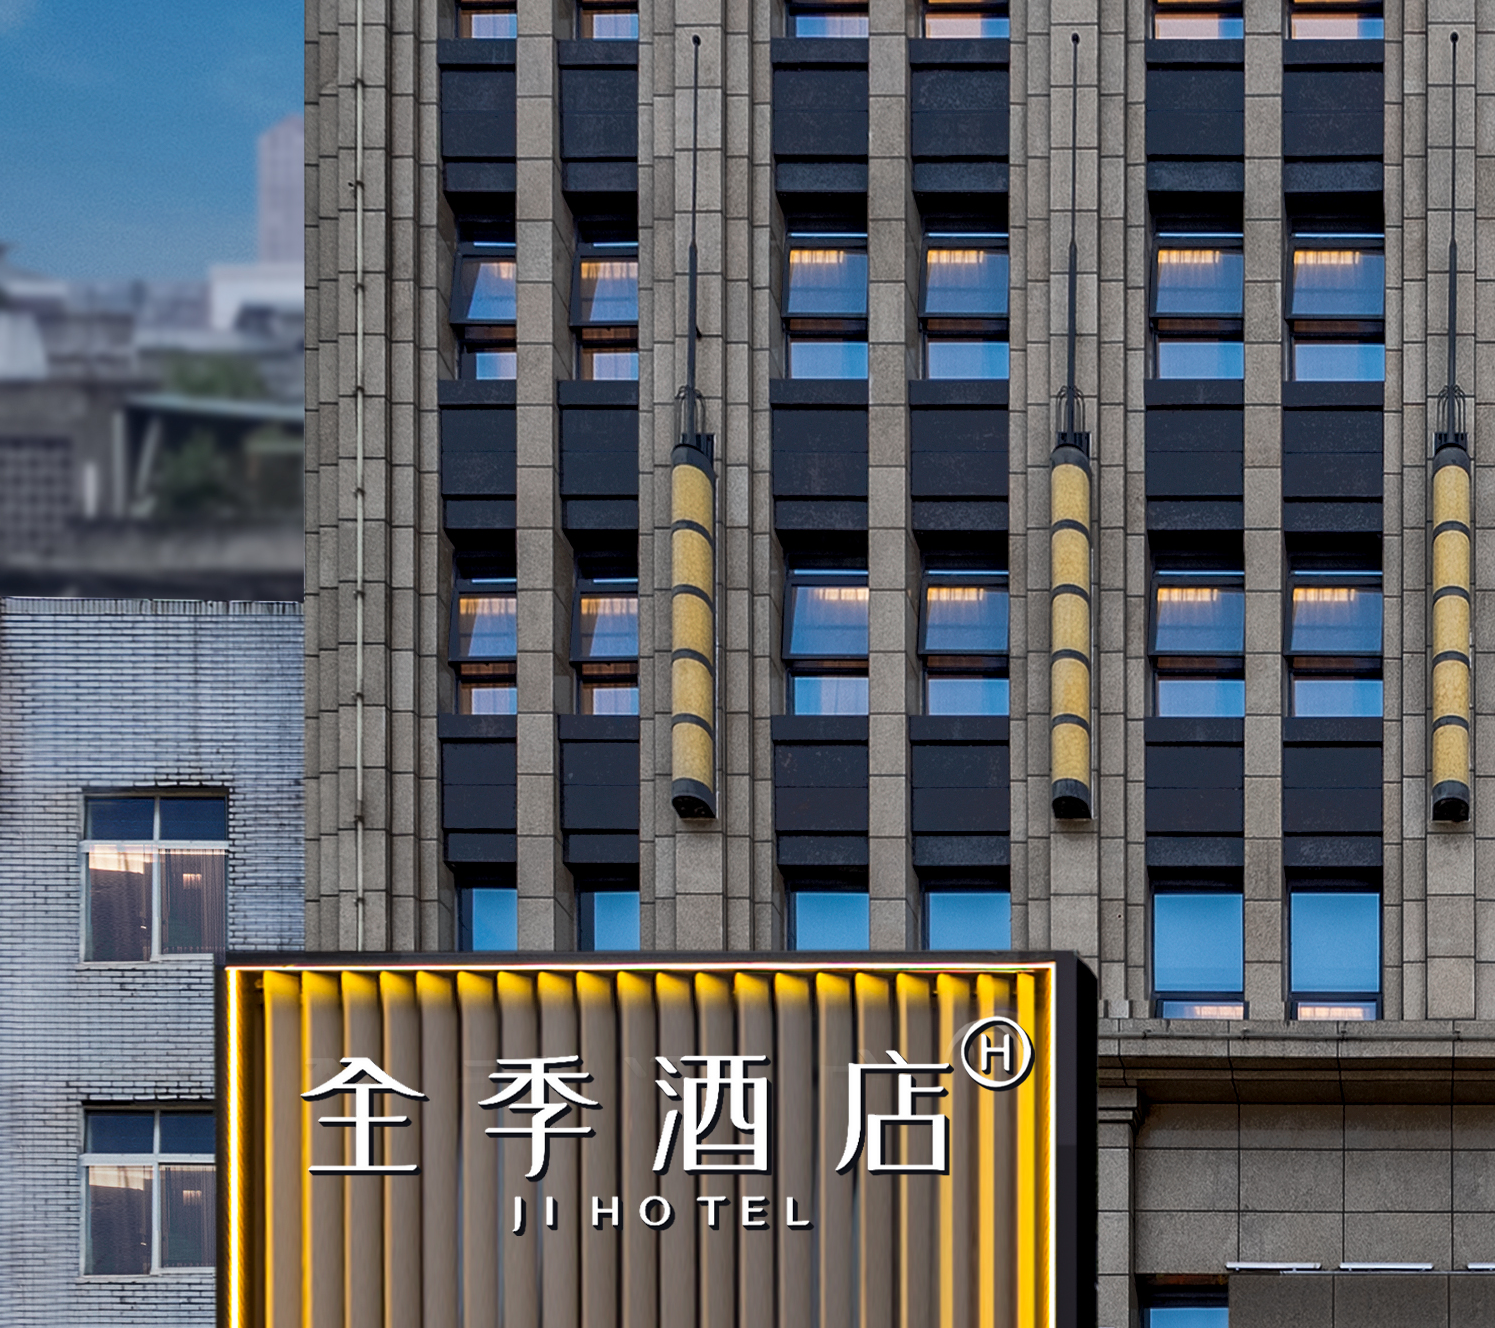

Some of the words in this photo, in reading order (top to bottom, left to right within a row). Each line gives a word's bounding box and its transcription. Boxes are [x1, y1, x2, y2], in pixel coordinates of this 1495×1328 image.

[300, 1048, 955, 1179] 全季酒店
[511, 1195, 555, 1233] JI
[591, 1194, 811, 1228] HOTEL
